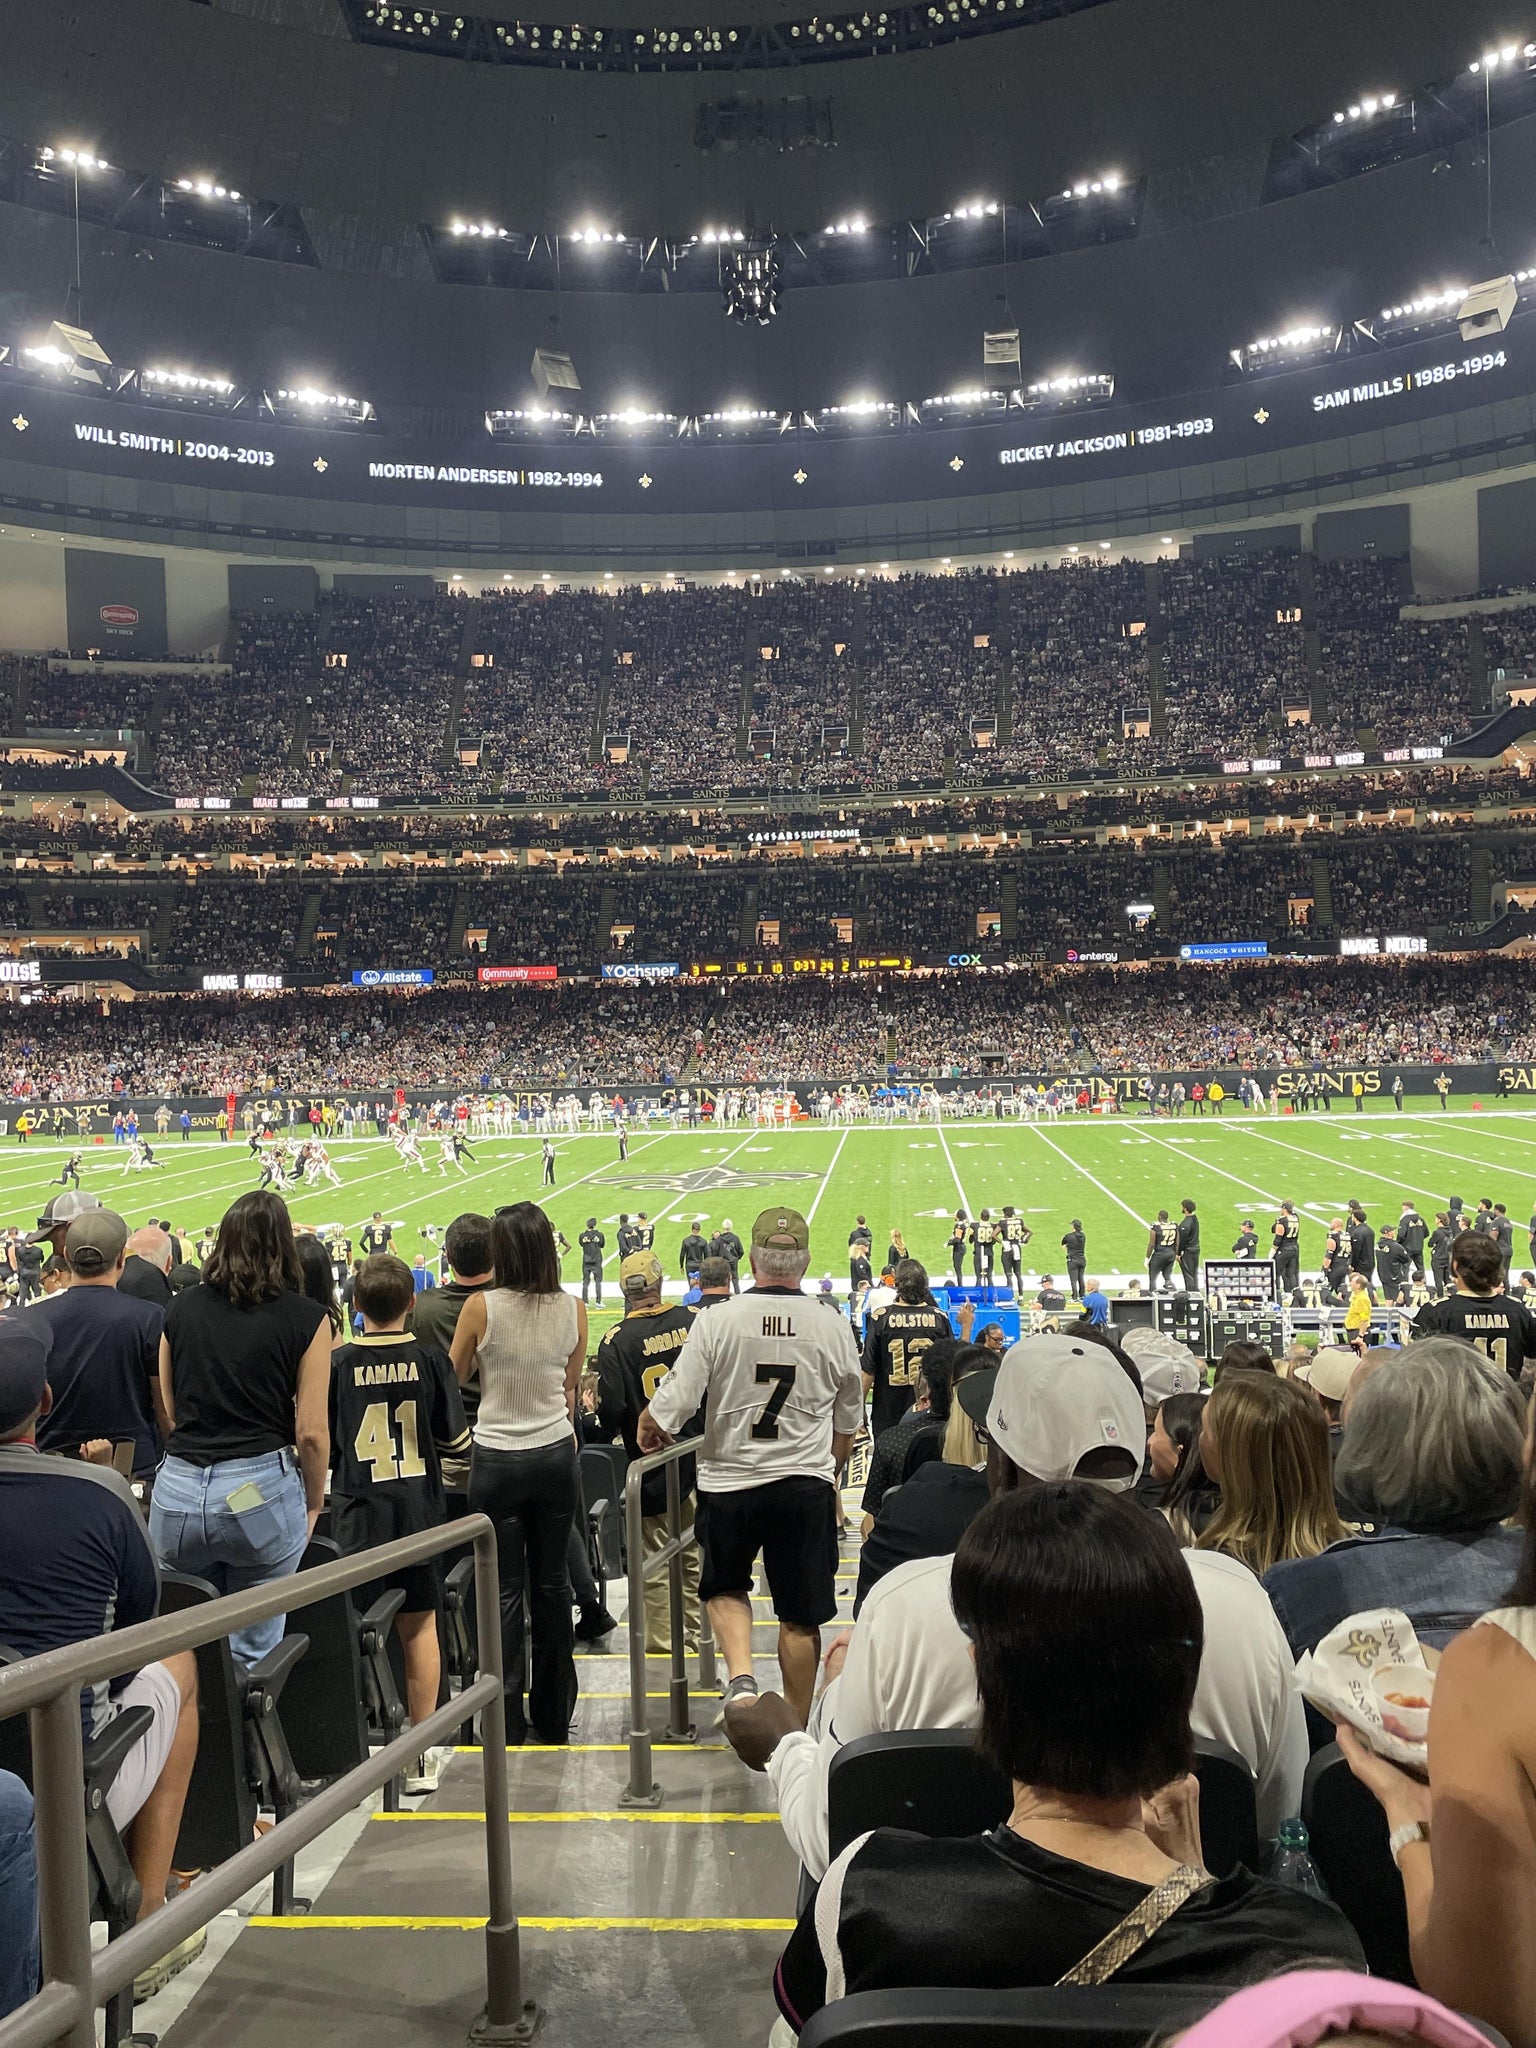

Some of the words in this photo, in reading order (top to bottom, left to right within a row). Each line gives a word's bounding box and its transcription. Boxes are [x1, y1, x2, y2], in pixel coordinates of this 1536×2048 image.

[1313, 389, 1350, 411] SAM
[1353, 377, 1403, 402] MILLS
[1414, 351, 1507, 387] 1986-1994
[75, 424, 117, 445] WILL
[119, 432, 174, 454] SMITH
[185, 442, 275, 466] 2004-2013
[1001, 444, 1054, 464] RICKEY
[1056, 433, 1127, 457] JACKSON
[1137, 418, 1214, 444] 1981-1993
[369, 463, 435, 480] MORTEN
[437, 467, 518, 484] ANDERSEN
[527, 471, 603, 486] 1982-1994
[1384, 749, 1410, 762] MAKE
[1224, 761, 1250, 773] MAKE
[1304, 755, 1332, 768] MAKE
[1030, 773, 1069, 783] SAINTS
[1118, 768, 1157, 778] SAINTS
[861, 782, 899, 793] SAINTS
[944, 778, 983, 788] SAINTS
[525, 794, 563, 803] SAINTS
[609, 792, 646, 801] SAINTS
[693, 789, 730, 799] SAINTS
[1478, 790, 1520, 801] SAINTS
[175, 798, 200, 809] MAKE
[253, 797, 278, 808] MAKE
[326, 798, 349, 808] MAKE
[441, 795, 478, 805] SAINTS
[1387, 798, 1427, 808] SAINTS
[1212, 809, 1250, 819] SAINTS
[1299, 803, 1337, 814] SAINTS
[1047, 819, 1083, 828] SAINTS
[1129, 814, 1165, 824] SAINTS
[891, 826, 926, 836] SAINTS
[969, 823, 1004, 833] SAINTS
[683, 835, 717, 844] SAINTS
[748, 831, 800, 841] CAESARS
[801, 829, 860, 839] SUPERDOME
[39, 842, 79, 850] SAINTS
[211, 843, 248, 851] SAINTS
[293, 842, 329, 850] SAINTS
[373, 841, 409, 849] SAINTS
[452, 840, 487, 849] SAINTS
[530, 839, 564, 847] SAINTS
[606, 837, 640, 846] SAINTS
[126, 844, 164, 852] SAINTS
[1231, 946, 1267, 954] WHITNEY
[1341, 938, 1380, 955] MAKE
[948, 954, 982, 966] COX
[1008, 952, 1046, 962] SAINTS
[1080, 951, 1118, 962] entergy
[437, 970, 474, 979] SAINTS
[482, 968, 529, 980] Community
[614, 965, 676, 977] Ochsner
[203, 975, 239, 990] MAKE
[380, 972, 424, 983] Allstate
[1277, 1070, 1381, 1094] SAINTS
[374, 1230, 383, 1244] 6
[1161, 1230, 1176, 1245] 72
[331, 1245, 347, 1261] 45
[762, 1316, 796, 1337] HILL
[888, 1314, 936, 1329] COLSTON
[1464, 1314, 1510, 1329] KAMARA
[643, 1327, 688, 1356] JORDAN
[888, 1338, 935, 1386] 12
[354, 1361, 419, 1387] KAMARA
[751, 1363, 797, 1440] 7
[354, 1400, 426, 1483] 41
